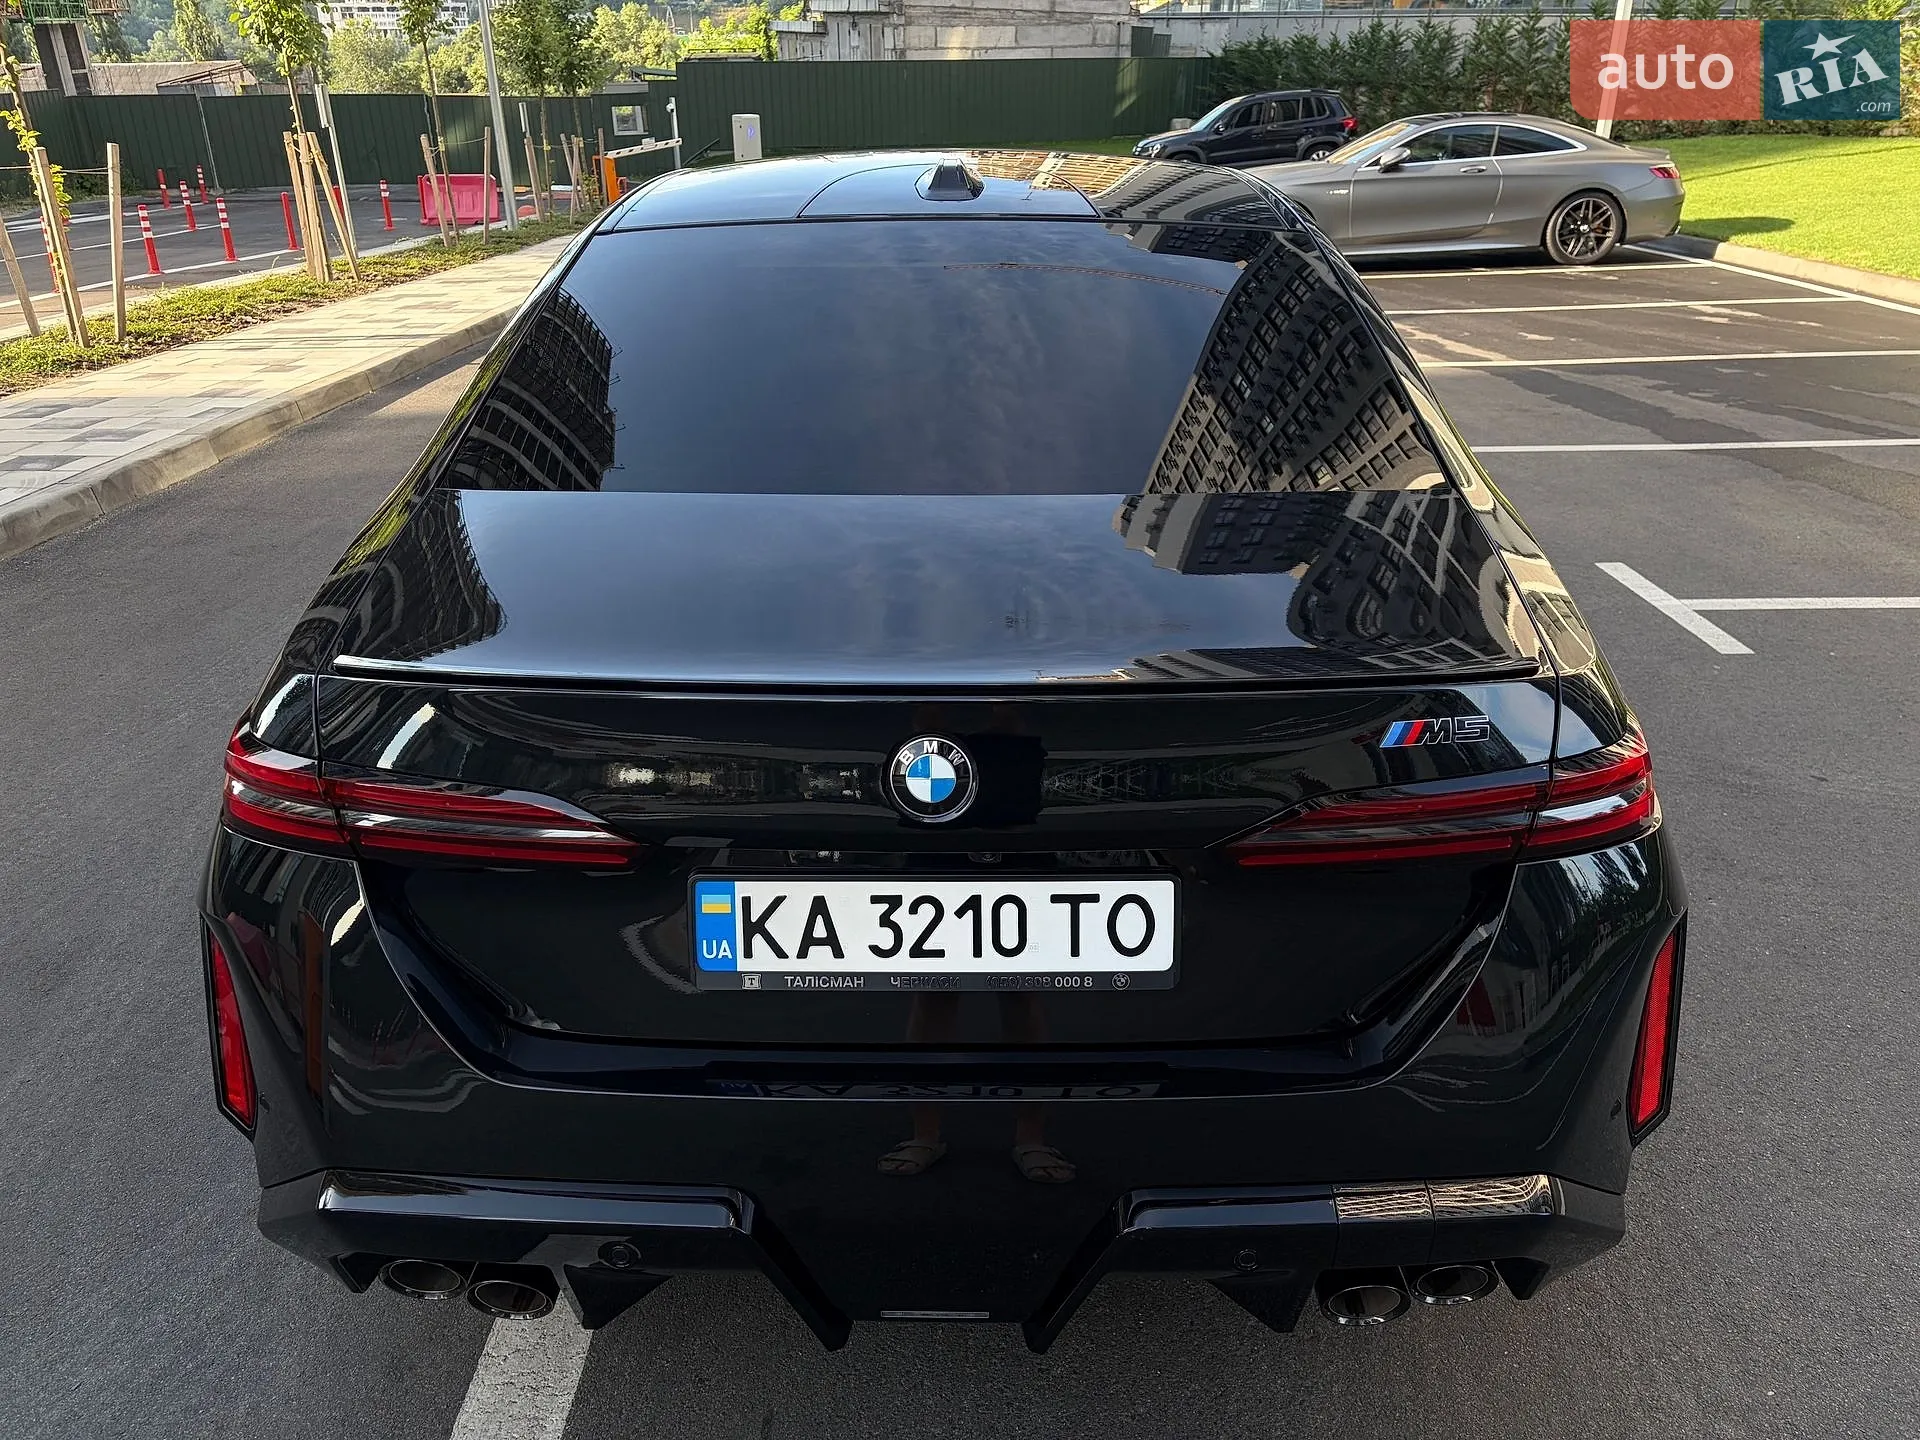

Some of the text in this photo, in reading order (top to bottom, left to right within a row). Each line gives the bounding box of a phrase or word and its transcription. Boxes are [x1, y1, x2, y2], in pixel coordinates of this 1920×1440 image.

[1416, 715, 1490, 745] M5
[898, 740, 965, 767] BMW
[741, 893, 1156, 960] KA 3210 TO
[702, 939, 733, 959] UA
[784, 976, 865, 989] ТАЛІСМАН
[1054, 976, 1081, 988] 000
[1083, 976, 1093, 988] 8
